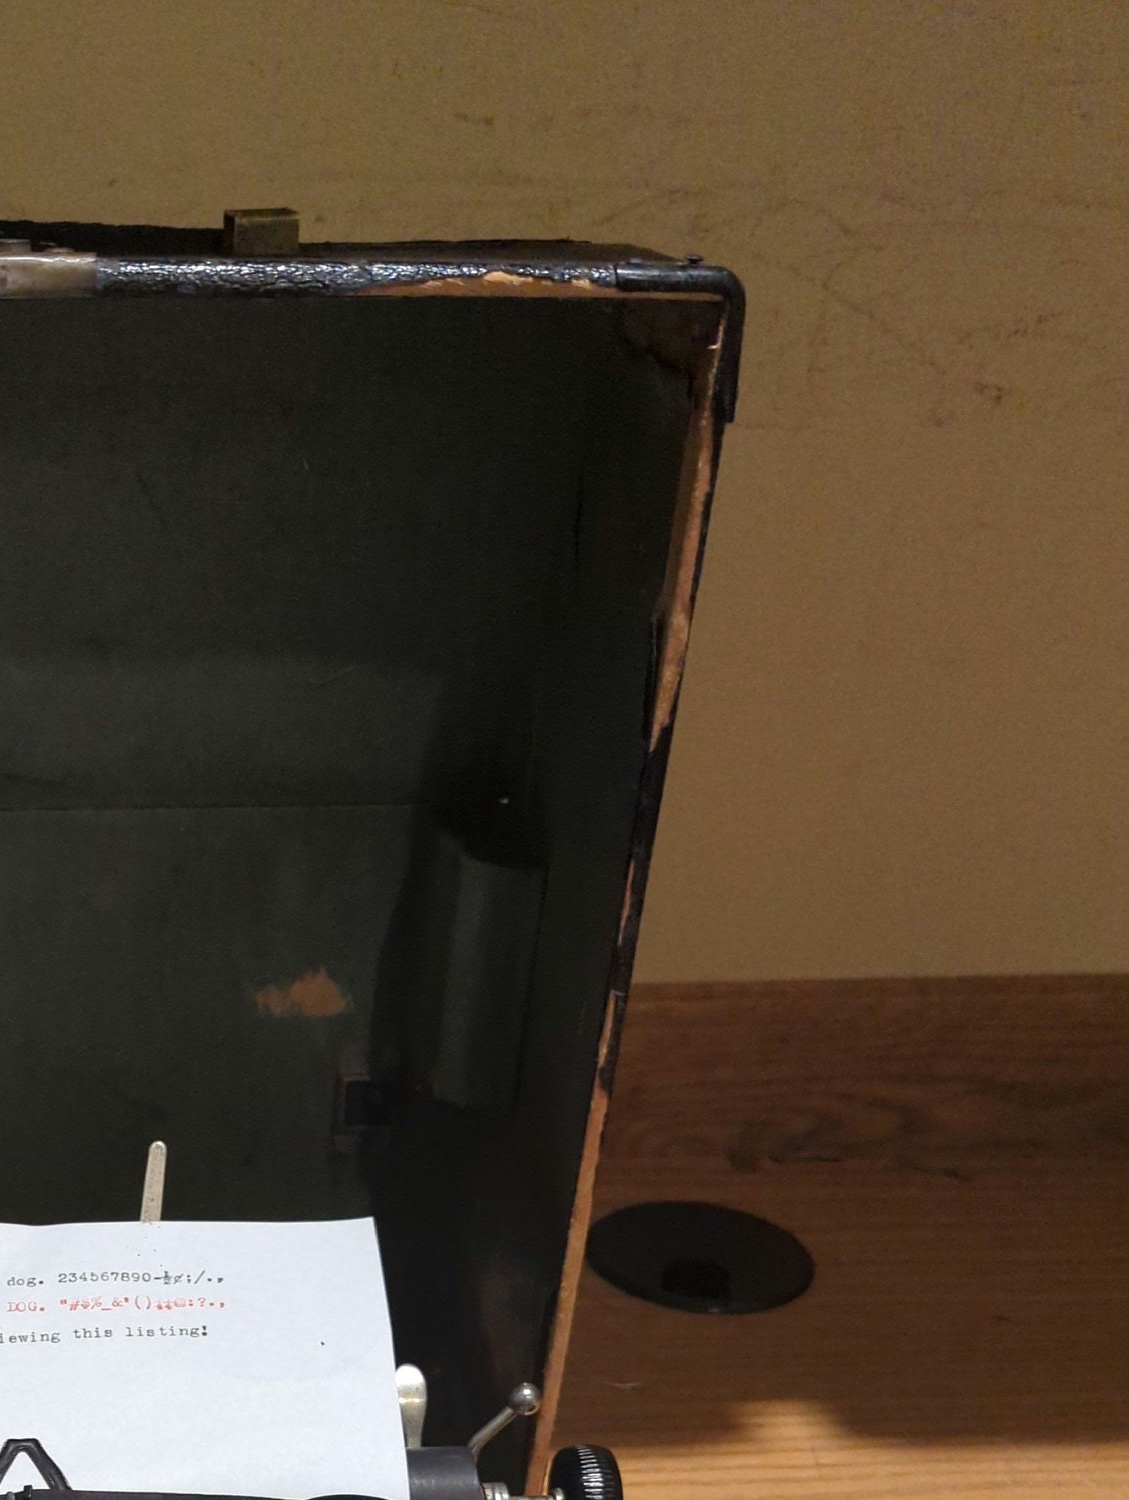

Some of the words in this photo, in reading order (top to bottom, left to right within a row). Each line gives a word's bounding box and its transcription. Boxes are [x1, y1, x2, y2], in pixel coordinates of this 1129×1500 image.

[6, 1274, 45, 1290] dog.
[6, 1301, 46, 1313] DOG.
[73, 1326, 113, 1339] this
[125, 1324, 209, 1341] listing!
